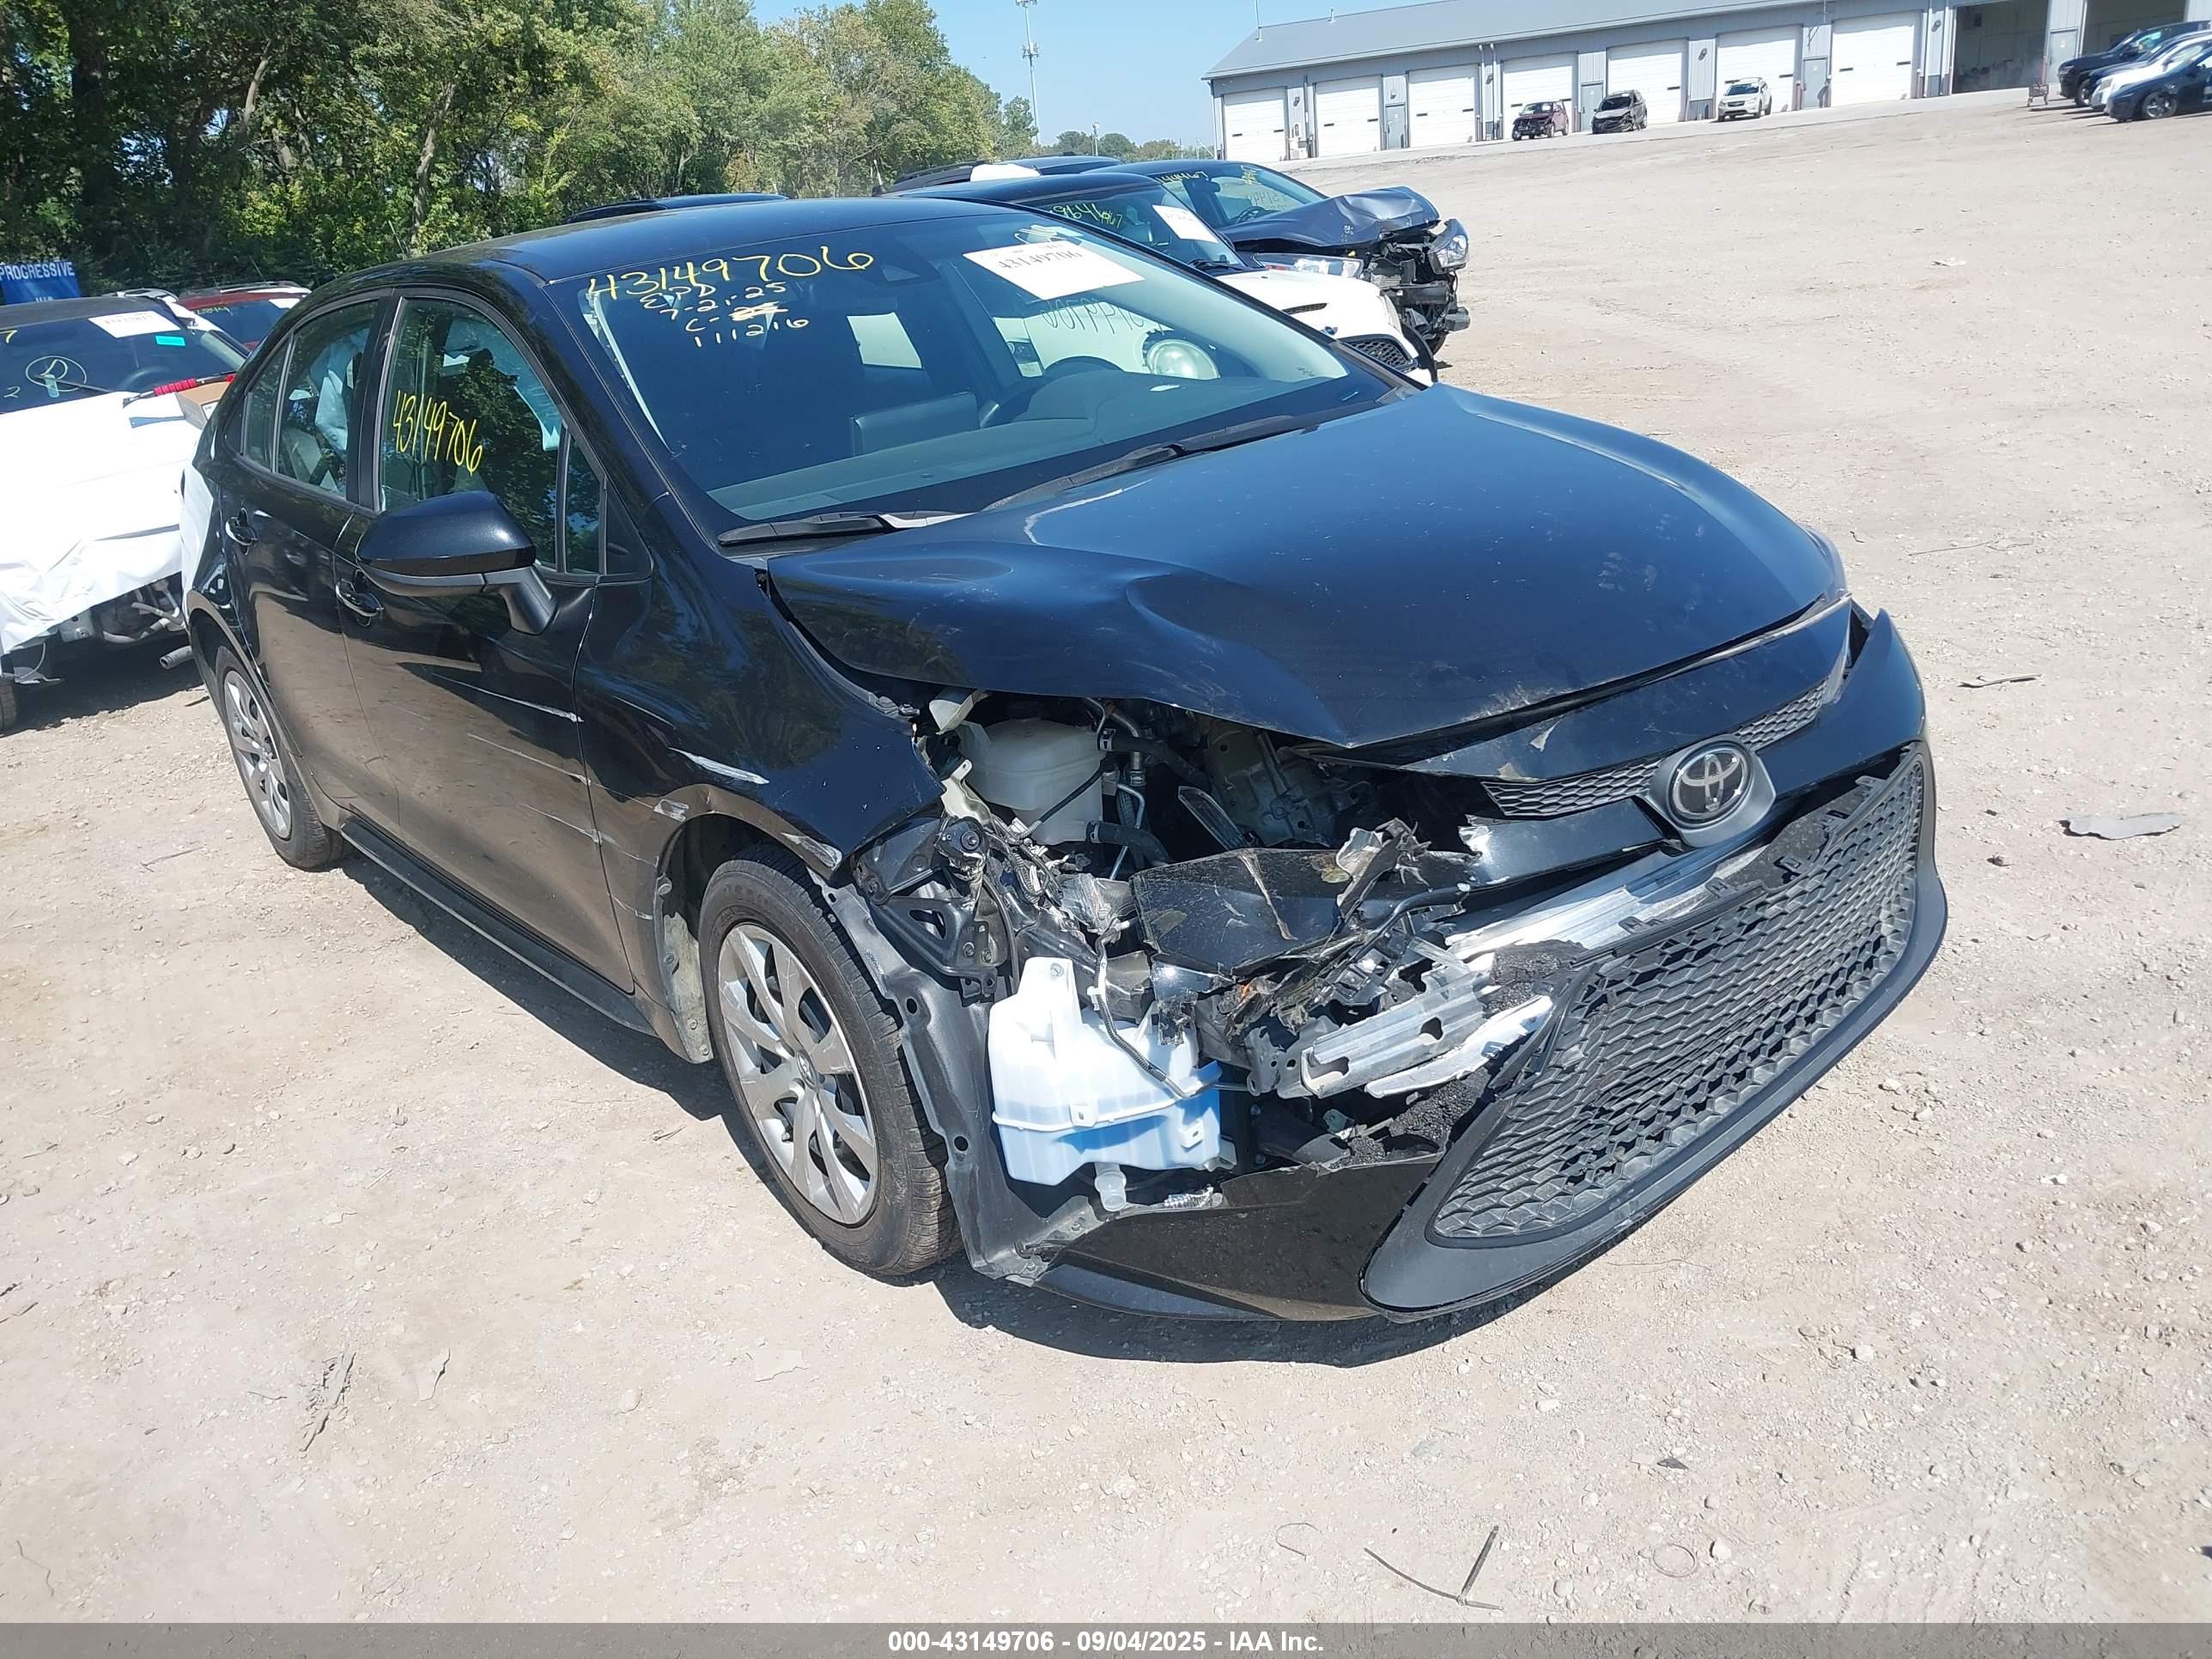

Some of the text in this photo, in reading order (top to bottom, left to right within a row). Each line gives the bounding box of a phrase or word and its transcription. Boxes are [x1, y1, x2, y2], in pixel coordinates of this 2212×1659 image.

[0, 261, 76, 282] PROGRESSIVE
[586, 246, 874, 301] 43149706
[392, 389, 483, 477] 43149706
